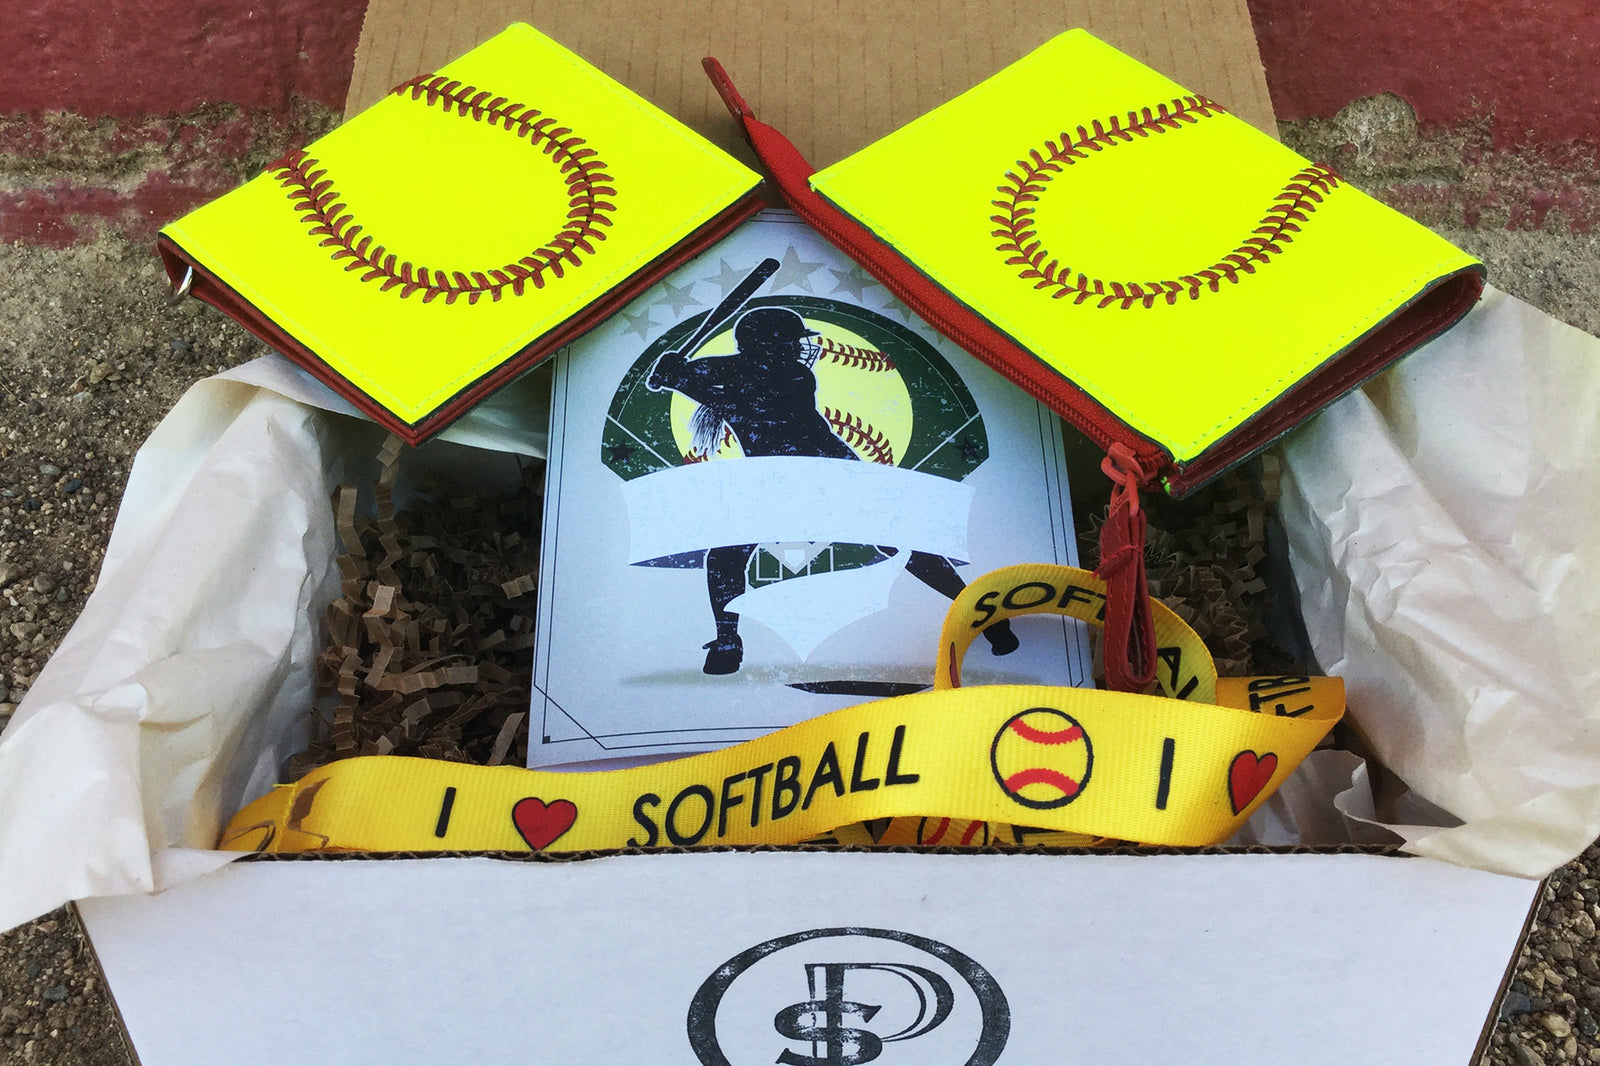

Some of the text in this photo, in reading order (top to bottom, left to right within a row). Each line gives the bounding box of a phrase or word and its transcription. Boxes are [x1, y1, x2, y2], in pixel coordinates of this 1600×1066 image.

[434, 724, 920, 847] I SOFTBALL
[1155, 737, 1176, 811] I
